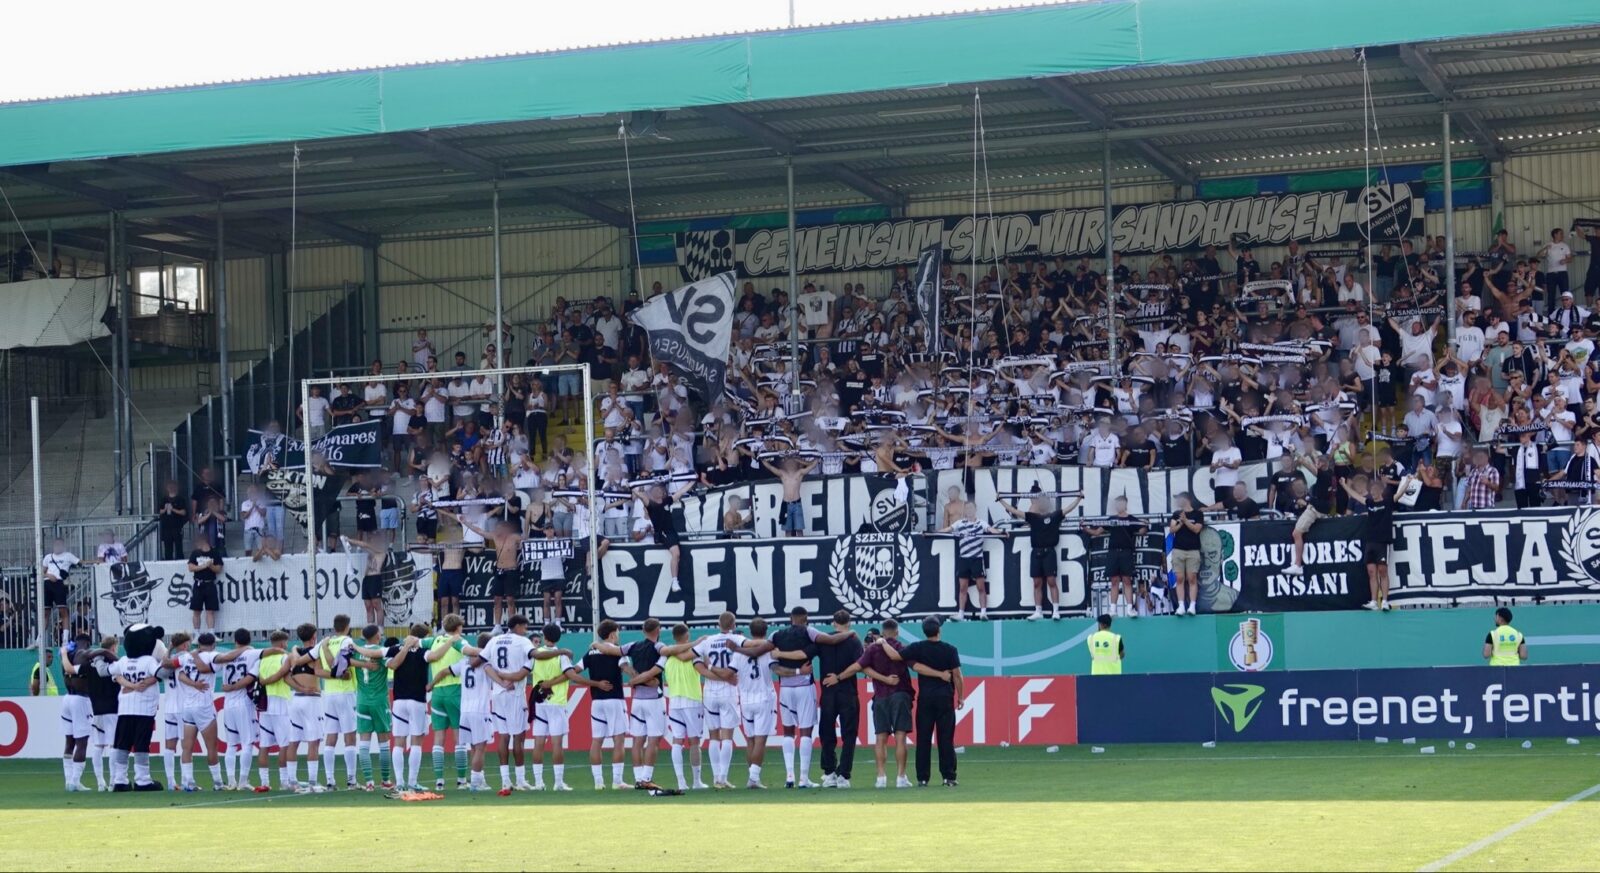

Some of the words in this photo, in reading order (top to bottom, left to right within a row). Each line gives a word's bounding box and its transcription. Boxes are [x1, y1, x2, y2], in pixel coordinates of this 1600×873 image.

[1364, 184, 1395, 213] SV
[744, 218, 945, 276] GEMEINSAM
[949, 214, 1033, 263] SIND
[1038, 208, 1106, 256] WIR
[1110, 190, 1347, 254] SANDHAUSEN
[1397, 307, 1442, 316] SANDHAUSEN
[1507, 421, 1549, 433] SANDHAUS
[524, 540, 572, 552] FREIHEIT
[855, 533, 895, 543] SZENE
[525, 550, 544, 561] FÜR
[1243, 539, 1363, 567] FAUTORES
[1389, 521, 1558, 587] HEJA
[300, 568, 362, 600] 1916
[602, 544, 820, 618] SZENE
[1266, 572, 1349, 597] INSANI
[863, 589, 889, 600] 1916
[497, 646, 508, 669] 8
[465, 666, 475, 688] 6
[1279, 688, 1474, 734] freenet,
